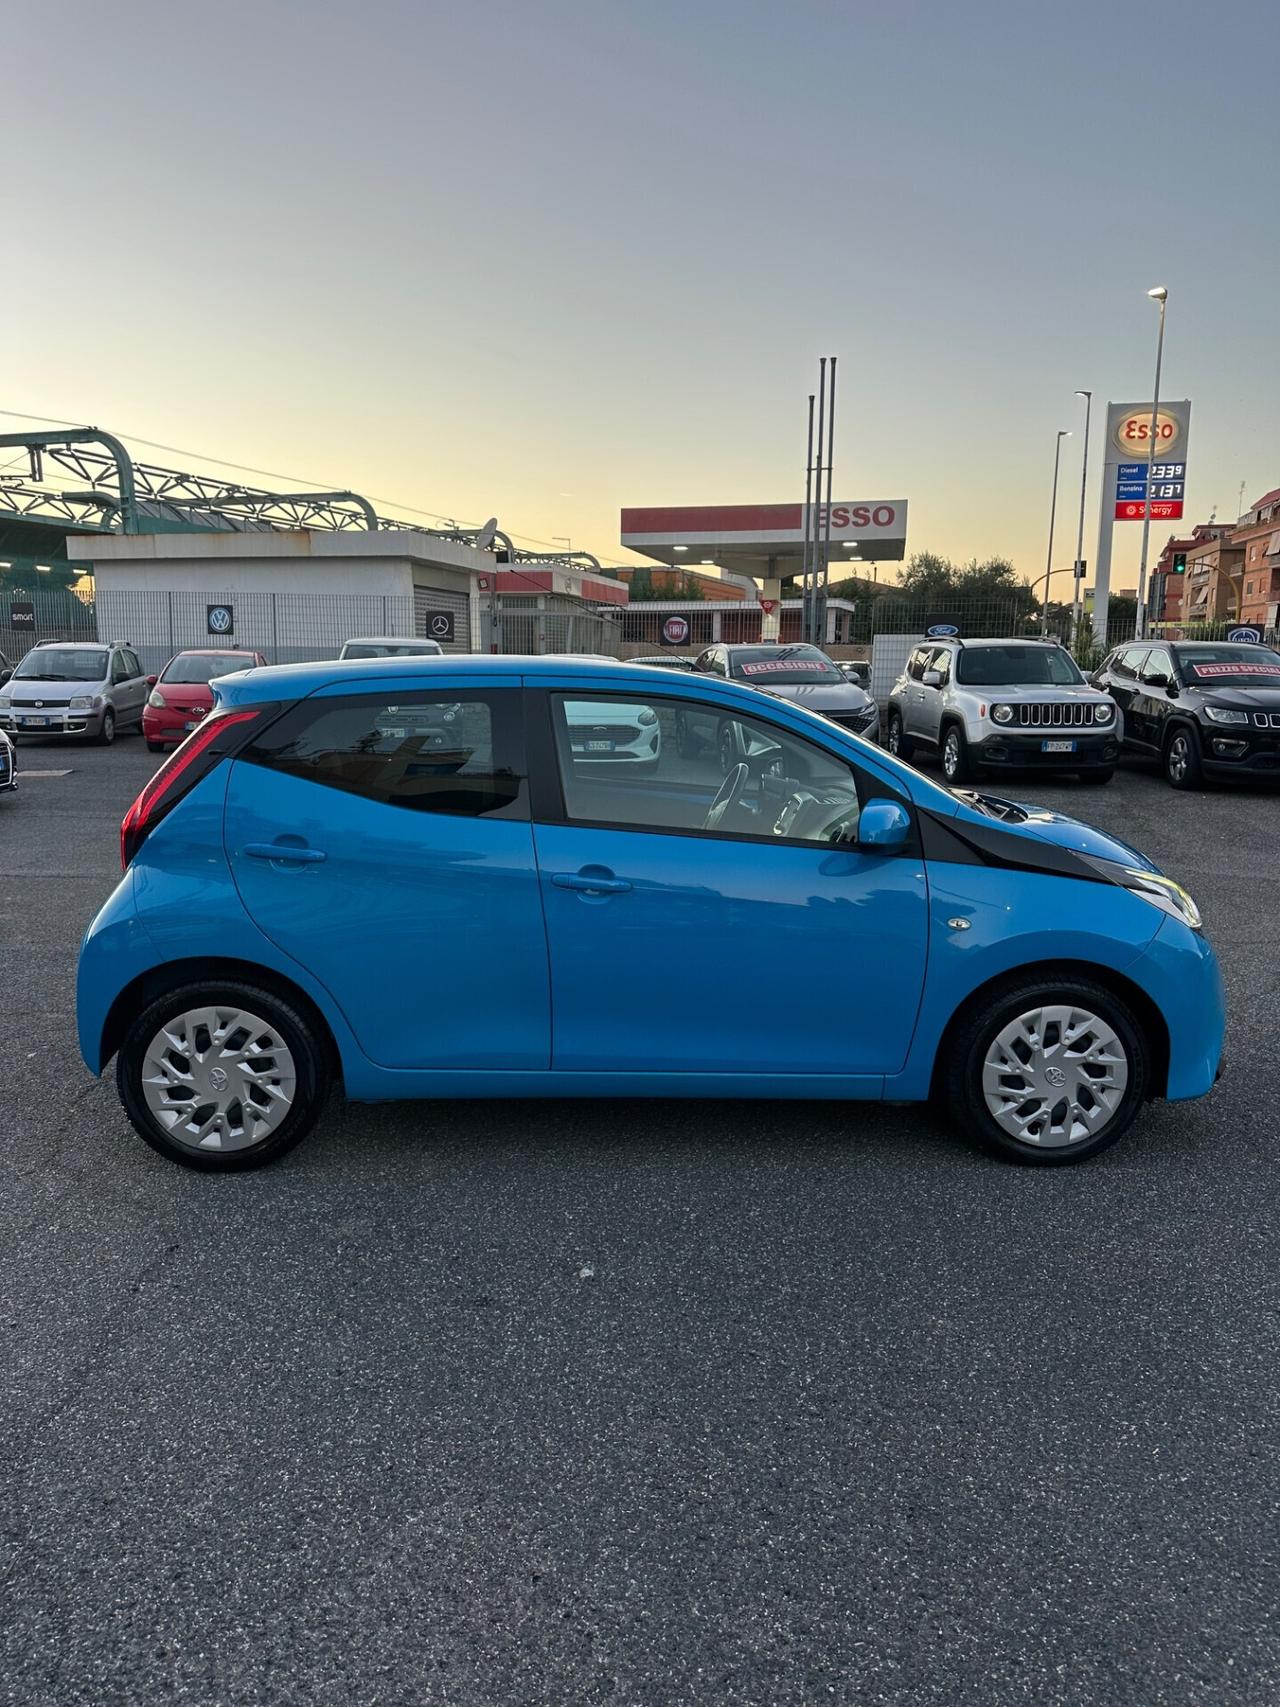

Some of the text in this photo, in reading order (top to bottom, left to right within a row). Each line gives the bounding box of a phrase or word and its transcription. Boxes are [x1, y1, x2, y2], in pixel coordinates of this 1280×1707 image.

[12, 612, 34, 621] smart
[749, 663, 824, 673] OCCASIONE
[1201, 665, 1239, 675] PREZZO
